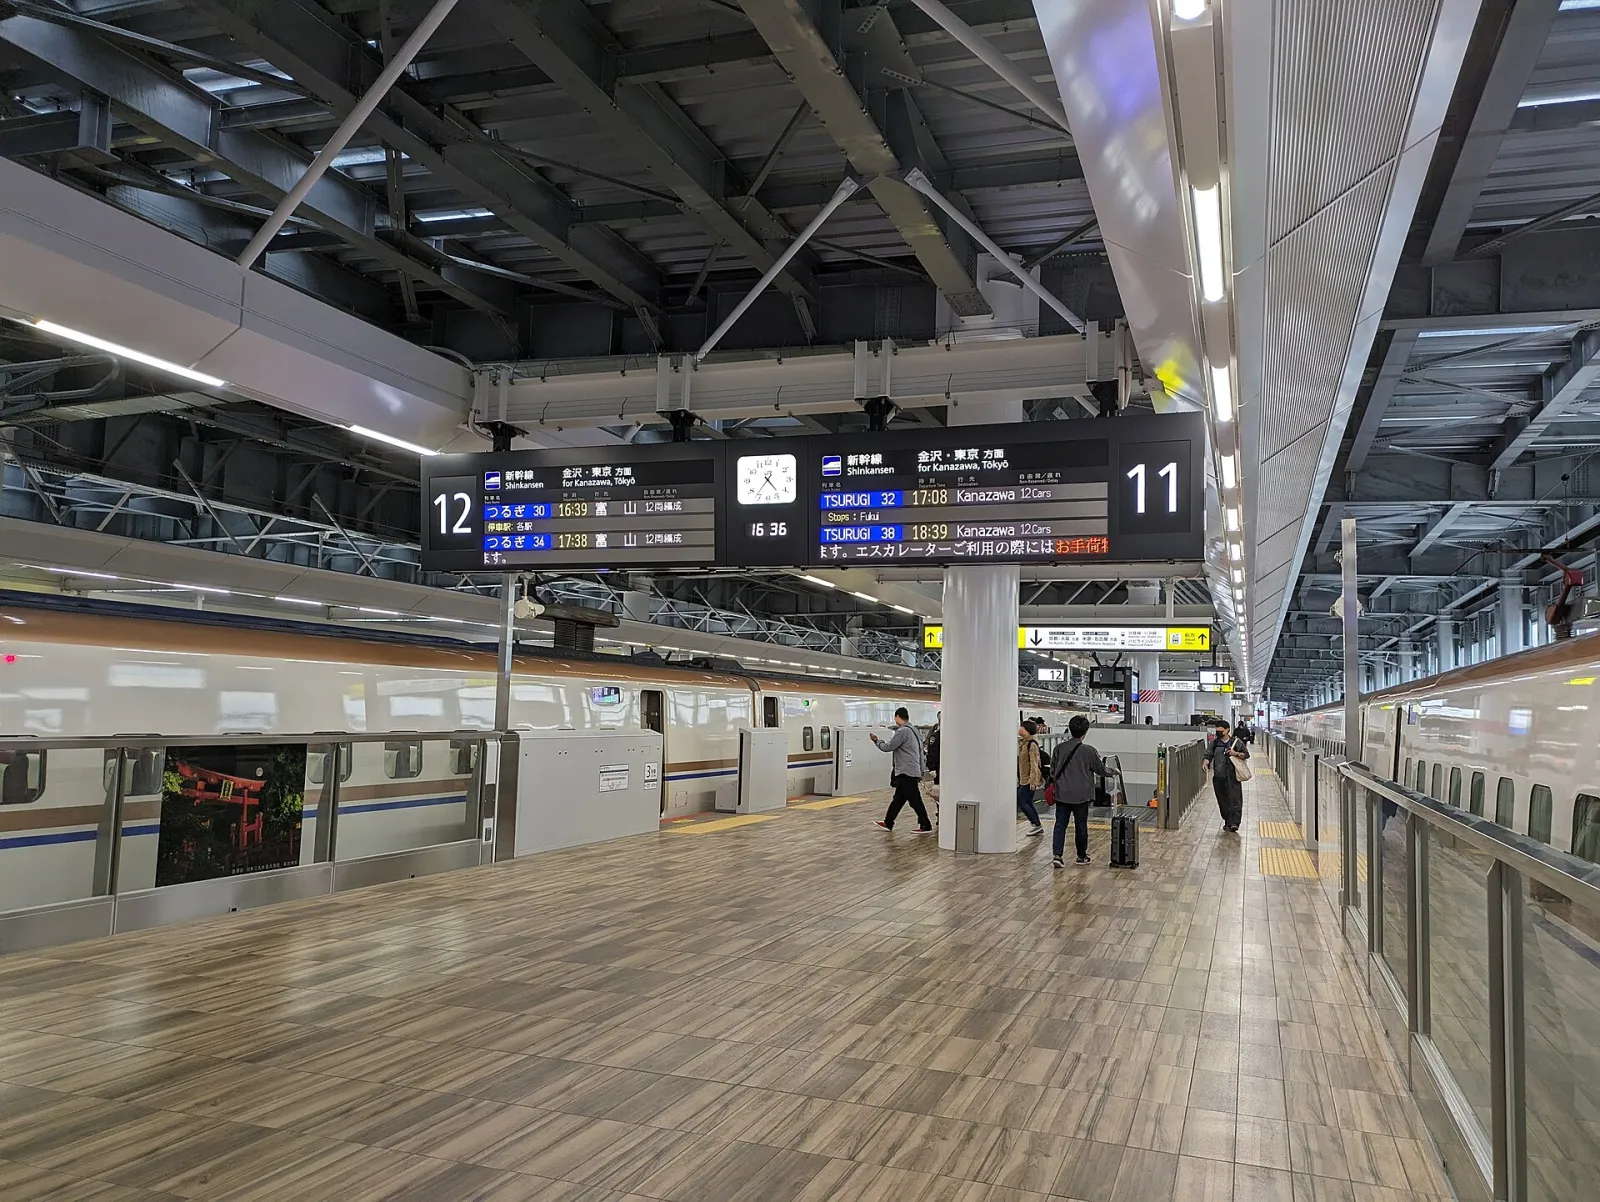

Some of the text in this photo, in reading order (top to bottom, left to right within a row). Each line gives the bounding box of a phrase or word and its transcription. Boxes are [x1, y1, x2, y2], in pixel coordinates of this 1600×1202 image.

[847, 453, 883, 466] 新幹線
[917, 448, 1004, 462] 金沢・東京 方面
[562, 466, 632, 479] 金沢・東京 方面
[847, 466, 895, 476] Shinkansen
[918, 464, 932, 473] for
[933, 461, 981, 472] Kanazawa,
[505, 470, 534, 481] 新幹線
[505, 481, 544, 490] Shinkansen
[562, 479, 573, 488] for
[574, 477, 613, 487] Kanazawa,
[1126, 462, 1177, 513] 11
[823, 493, 871, 507] TSURUGI
[880, 492, 896, 505] 32
[912, 489, 948, 506] 17:08
[956, 489, 1016, 503] Kanazawa
[433, 492, 472, 534] 12
[487, 505, 526, 518] つるぎ
[533, 505, 546, 517] 30
[558, 502, 588, 517] 16:39
[859, 511, 880, 521] Fukui
[516, 521, 533, 531] 各駅
[752, 522, 787, 537] 16 36
[823, 527, 871, 541] TSURUGI
[880, 526, 896, 540] 38
[912, 523, 948, 540] 18:39
[956, 525, 1016, 538] Kanazawa
[487, 535, 526, 549] つるぎ
[533, 536, 545, 548] 34
[558, 533, 588, 548] 17:38
[1050, 670, 1062, 680] 12
[1213, 672, 1226, 683] 11
